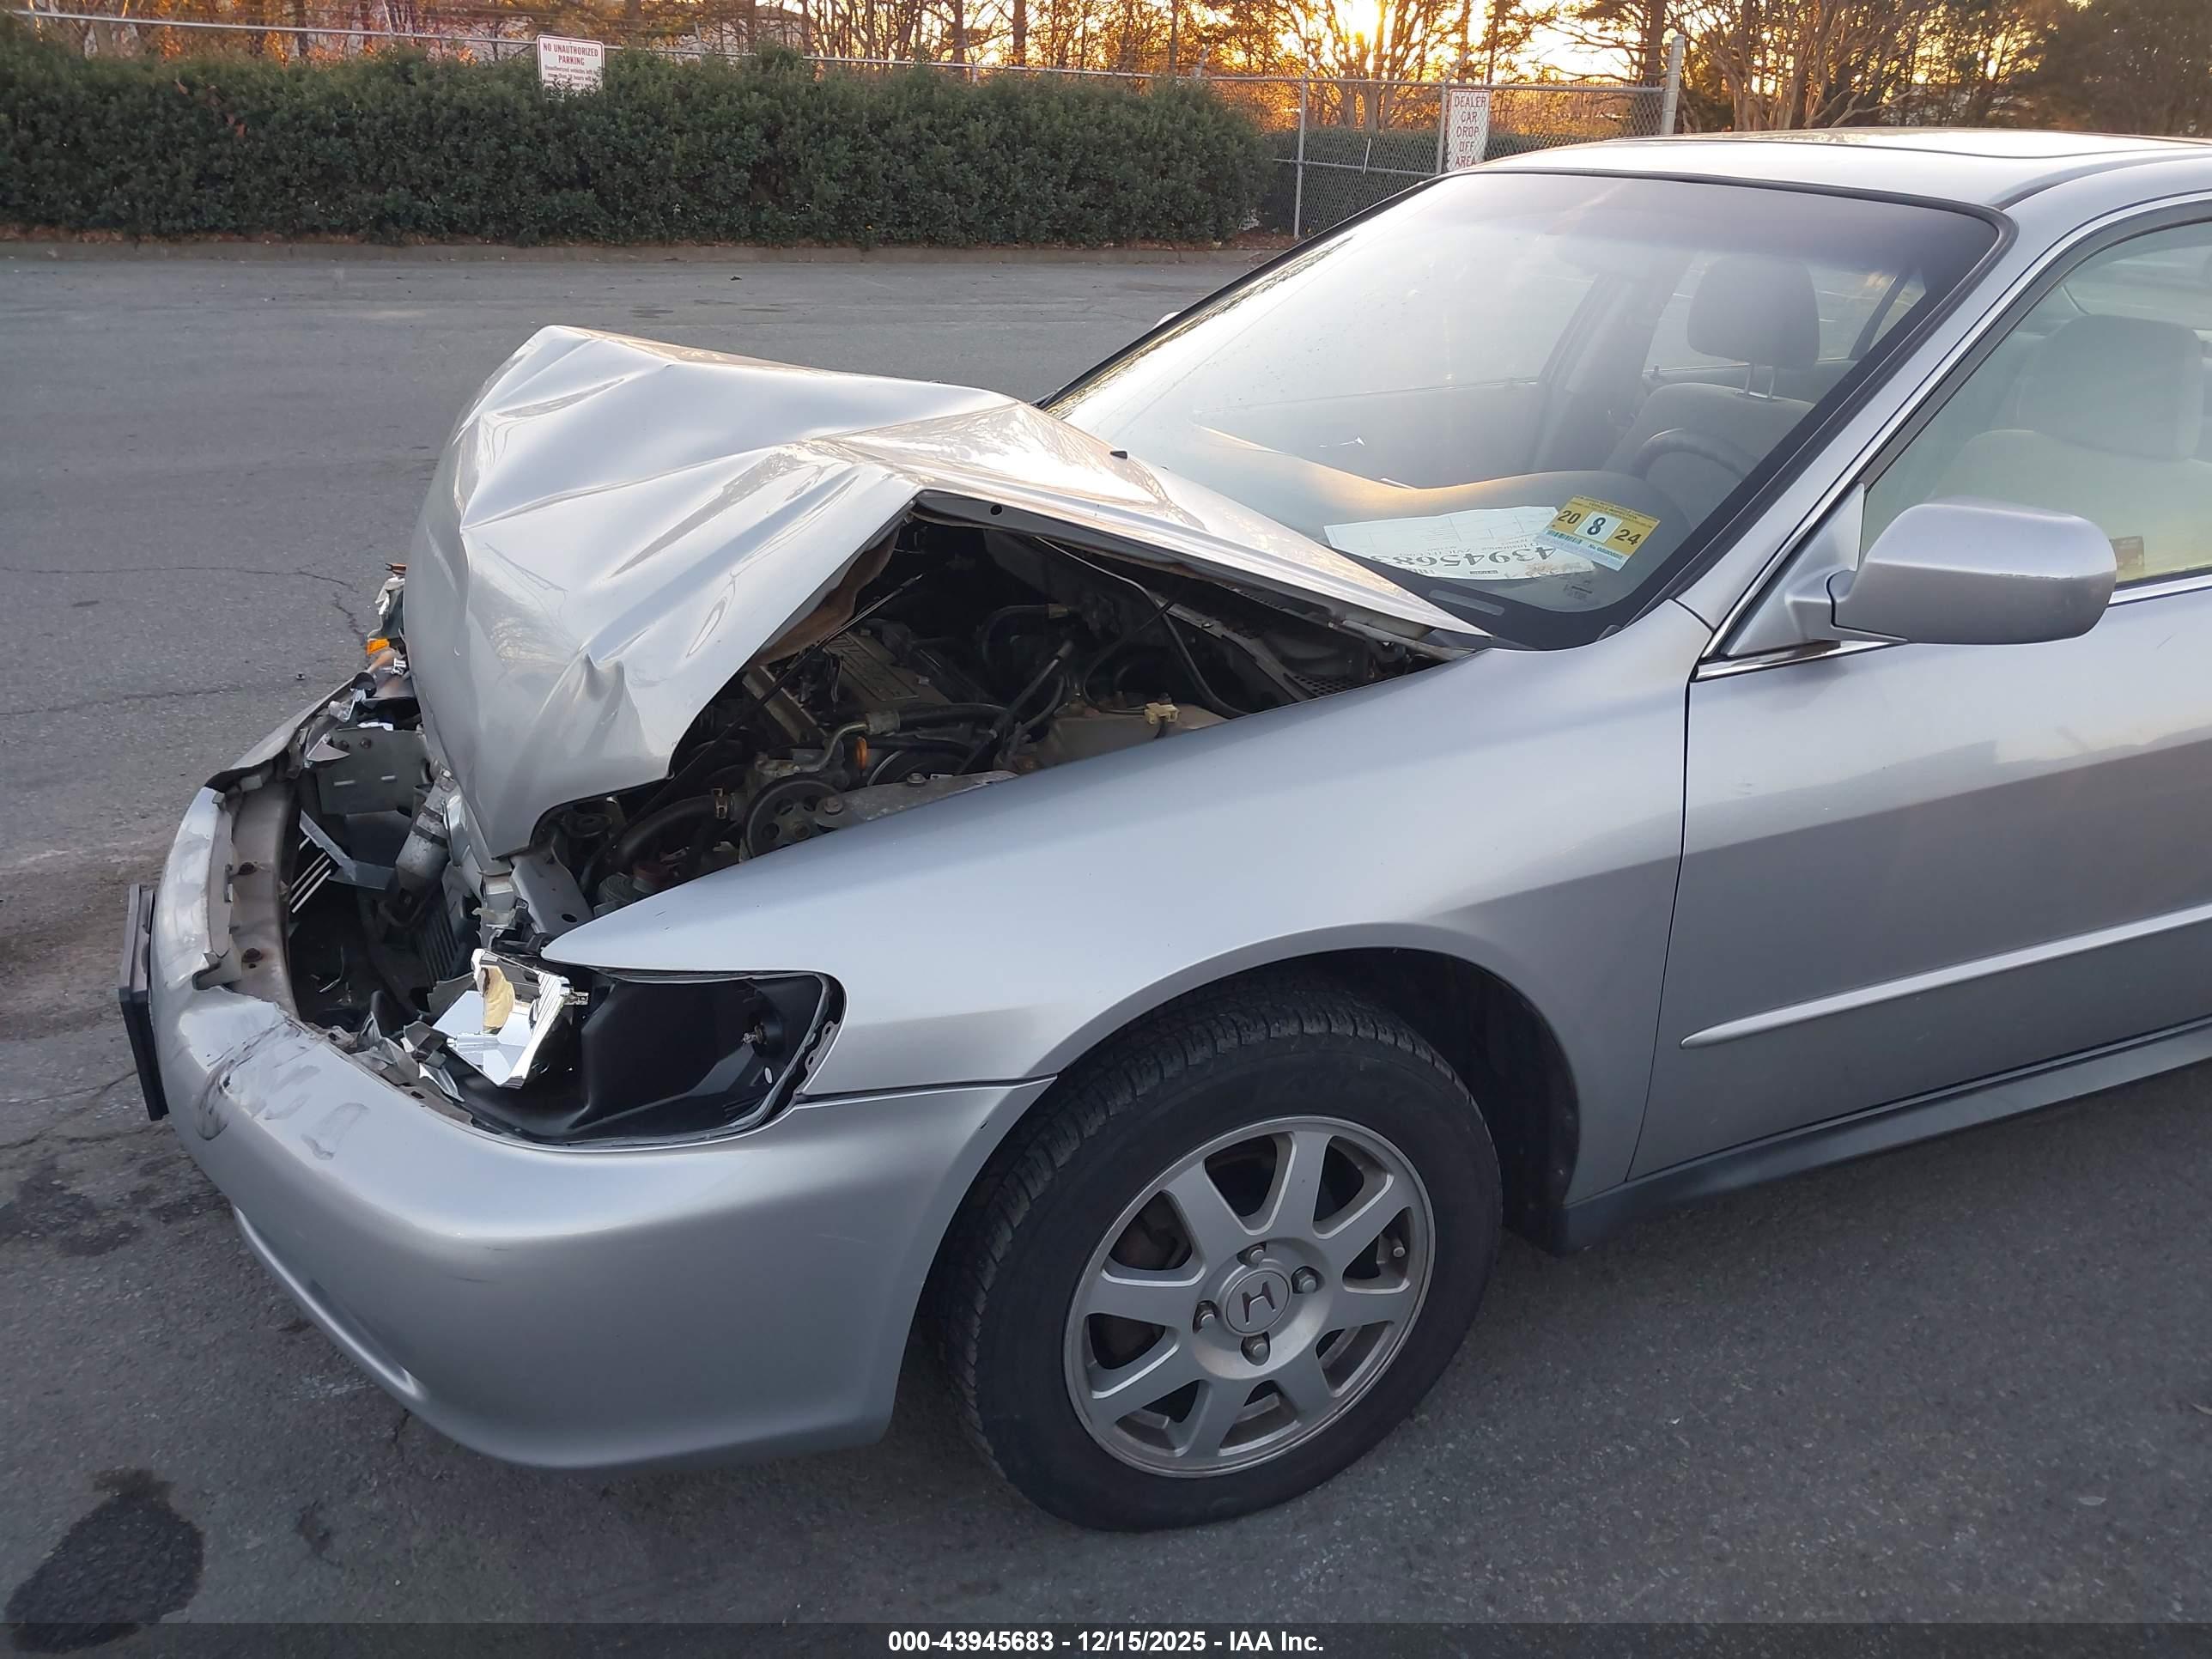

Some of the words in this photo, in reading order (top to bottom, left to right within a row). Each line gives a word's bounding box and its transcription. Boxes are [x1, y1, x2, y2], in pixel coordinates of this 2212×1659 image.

[543, 43, 552, 52] NO
[553, 44, 599, 58] UNAUTHORIZED
[558, 54, 585, 66] PARKING
[1454, 95, 1486, 108] DEALER
[1461, 111, 1478, 123] CAR
[1456, 125, 1480, 138] DROP
[1459, 141, 1475, 153] OFF
[1455, 155, 1476, 167] AREA
[1557, 510, 1582, 525] 20
[1586, 517, 1607, 536] 8
[1614, 528, 1643, 545] 24
